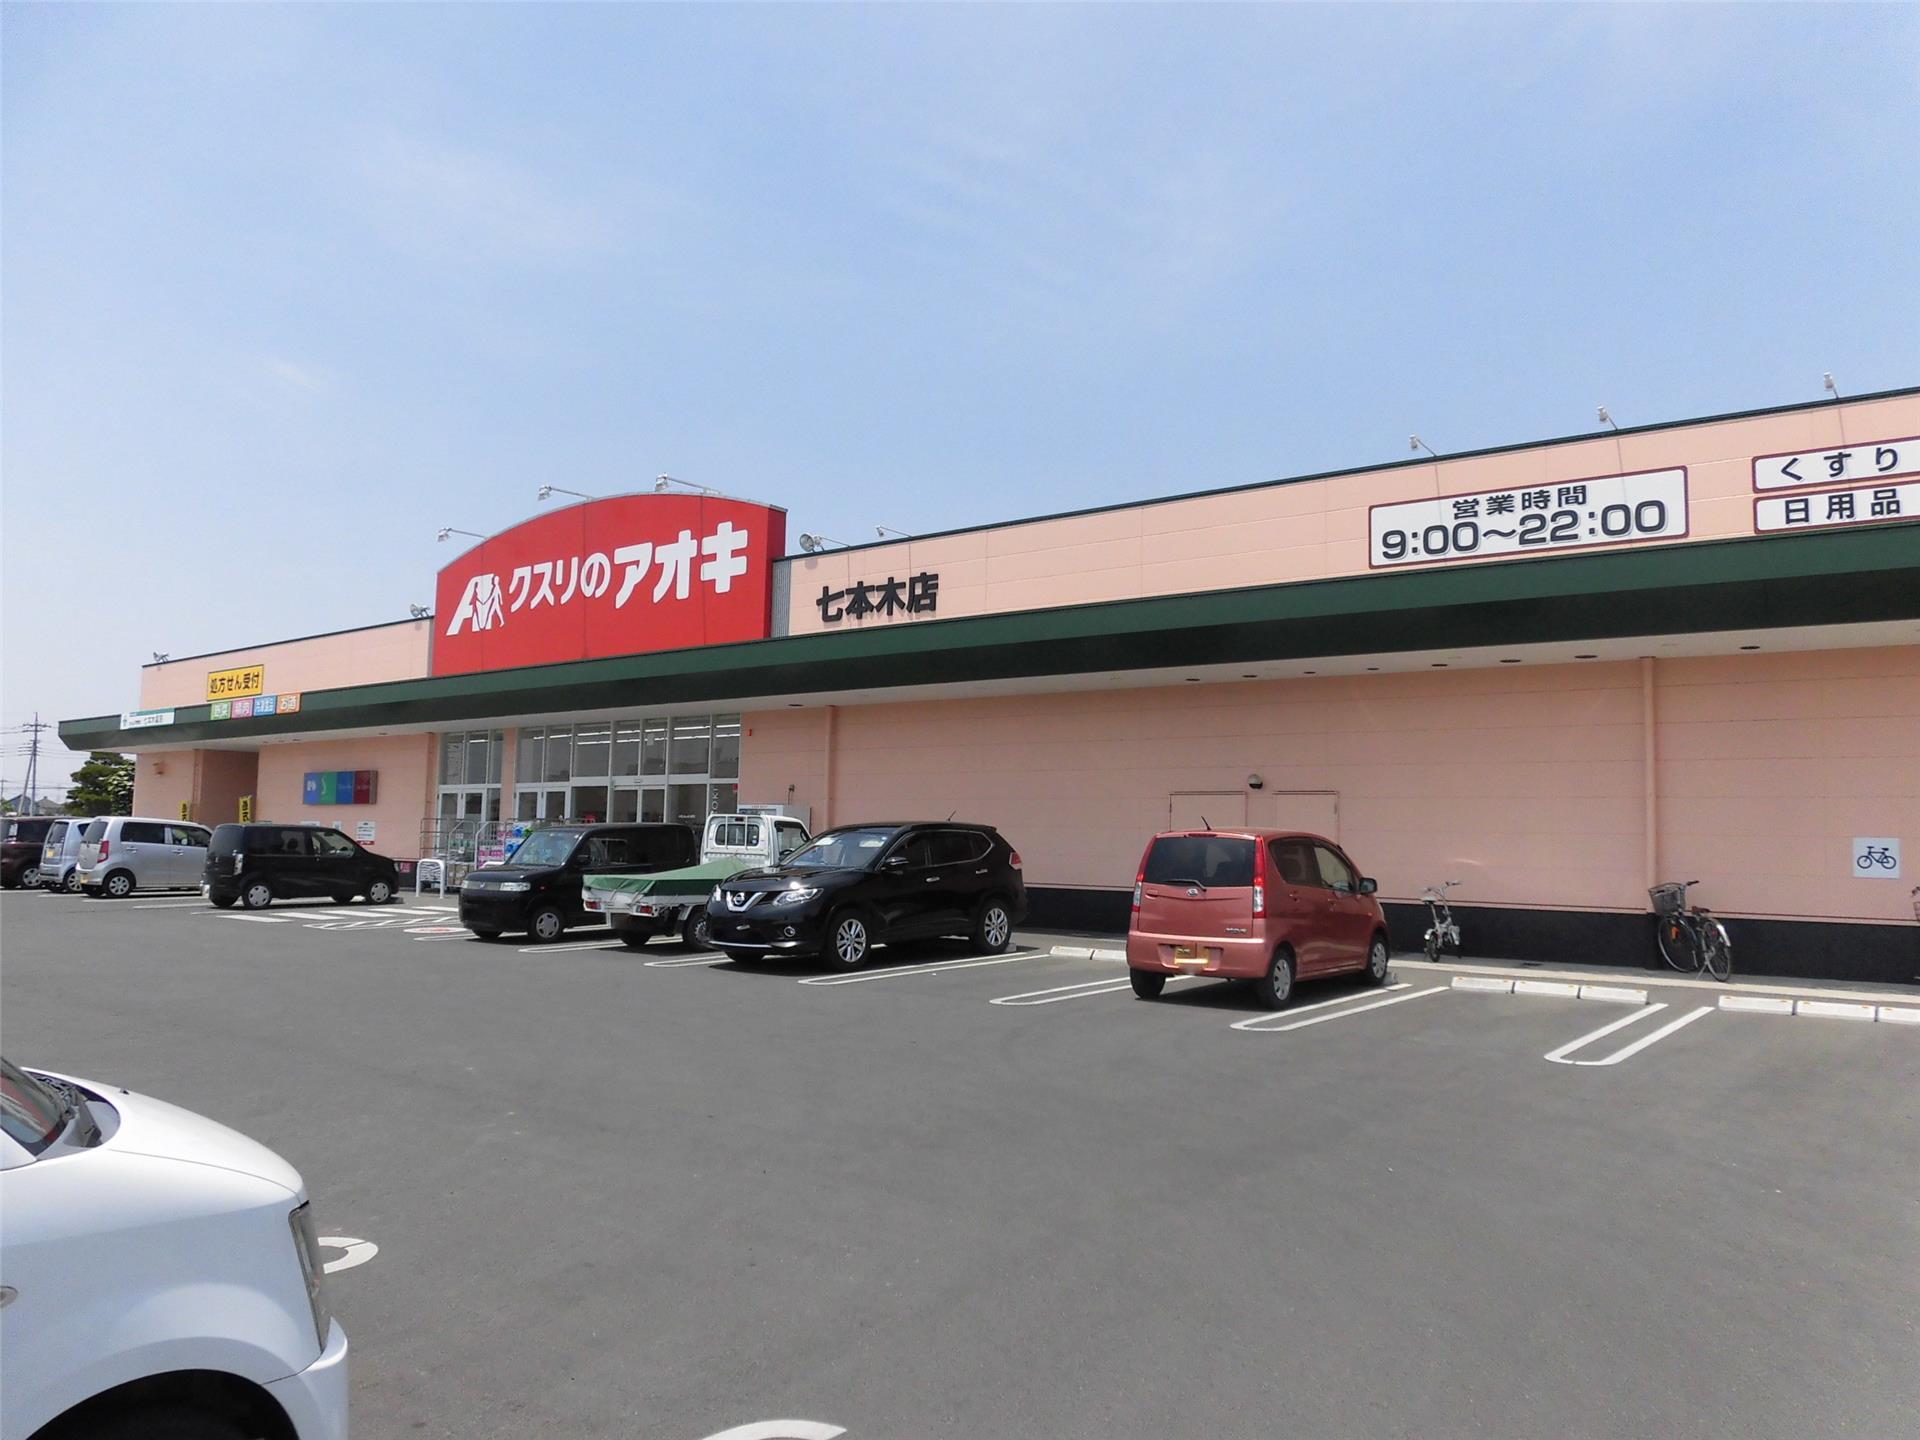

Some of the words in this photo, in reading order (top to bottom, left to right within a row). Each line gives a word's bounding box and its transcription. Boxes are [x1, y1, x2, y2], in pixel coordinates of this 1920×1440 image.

[1781, 447, 1898, 481] くすり
[1452, 484, 1587, 520] 営業時間
[1785, 488, 1900, 524] 日用品
[509, 521, 748, 612] クスリのアオキ
[816, 572, 939, 622] 七本木店
[210, 671, 260, 694] 処方せん受付
